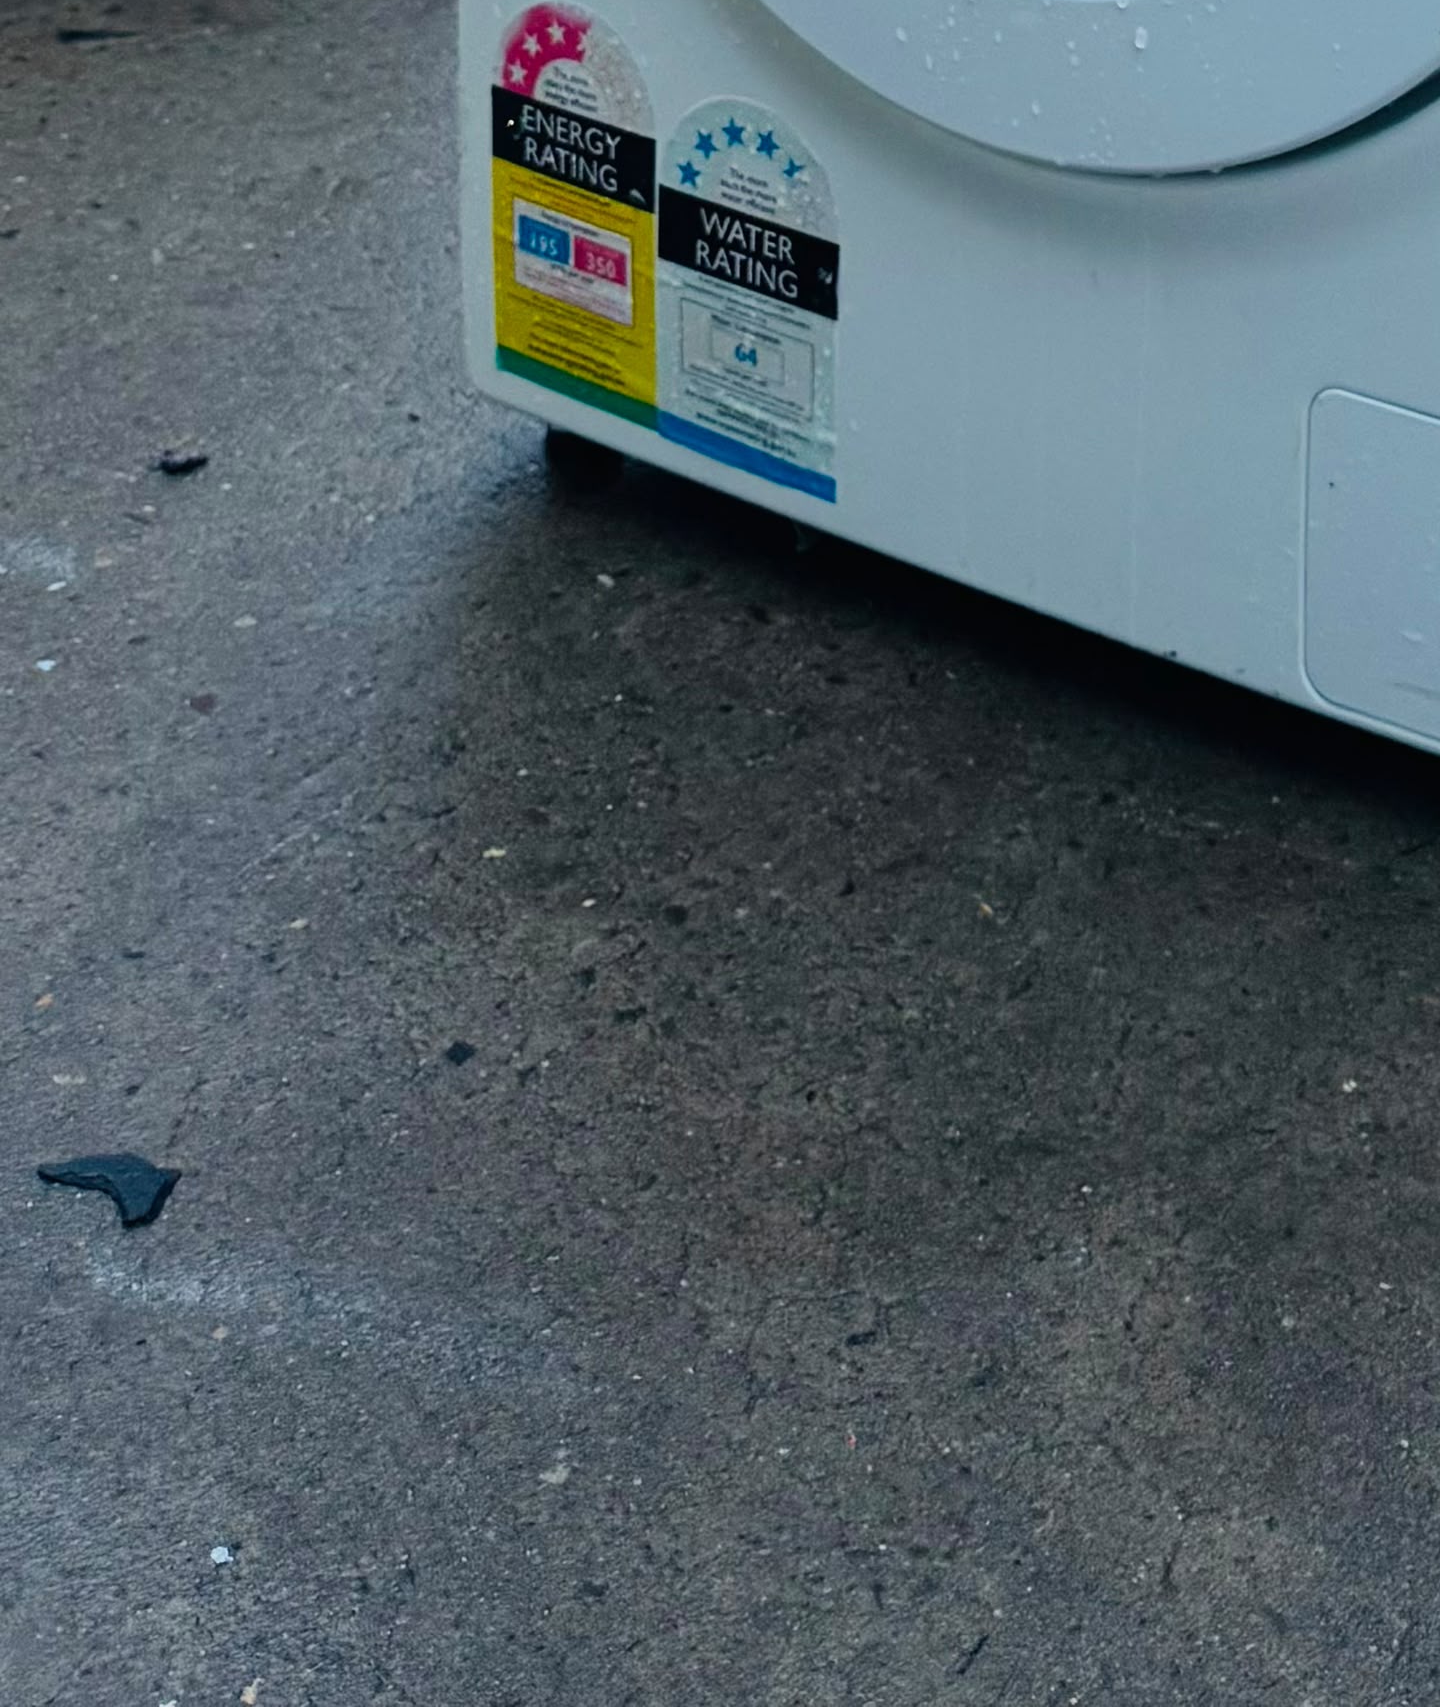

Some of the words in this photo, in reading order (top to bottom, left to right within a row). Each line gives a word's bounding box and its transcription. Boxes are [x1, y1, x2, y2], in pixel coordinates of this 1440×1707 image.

[522, 104, 621, 159] ENERGY
[524, 137, 618, 191] RATING
[700, 207, 795, 265] WATER
[695, 239, 798, 298] RATING
